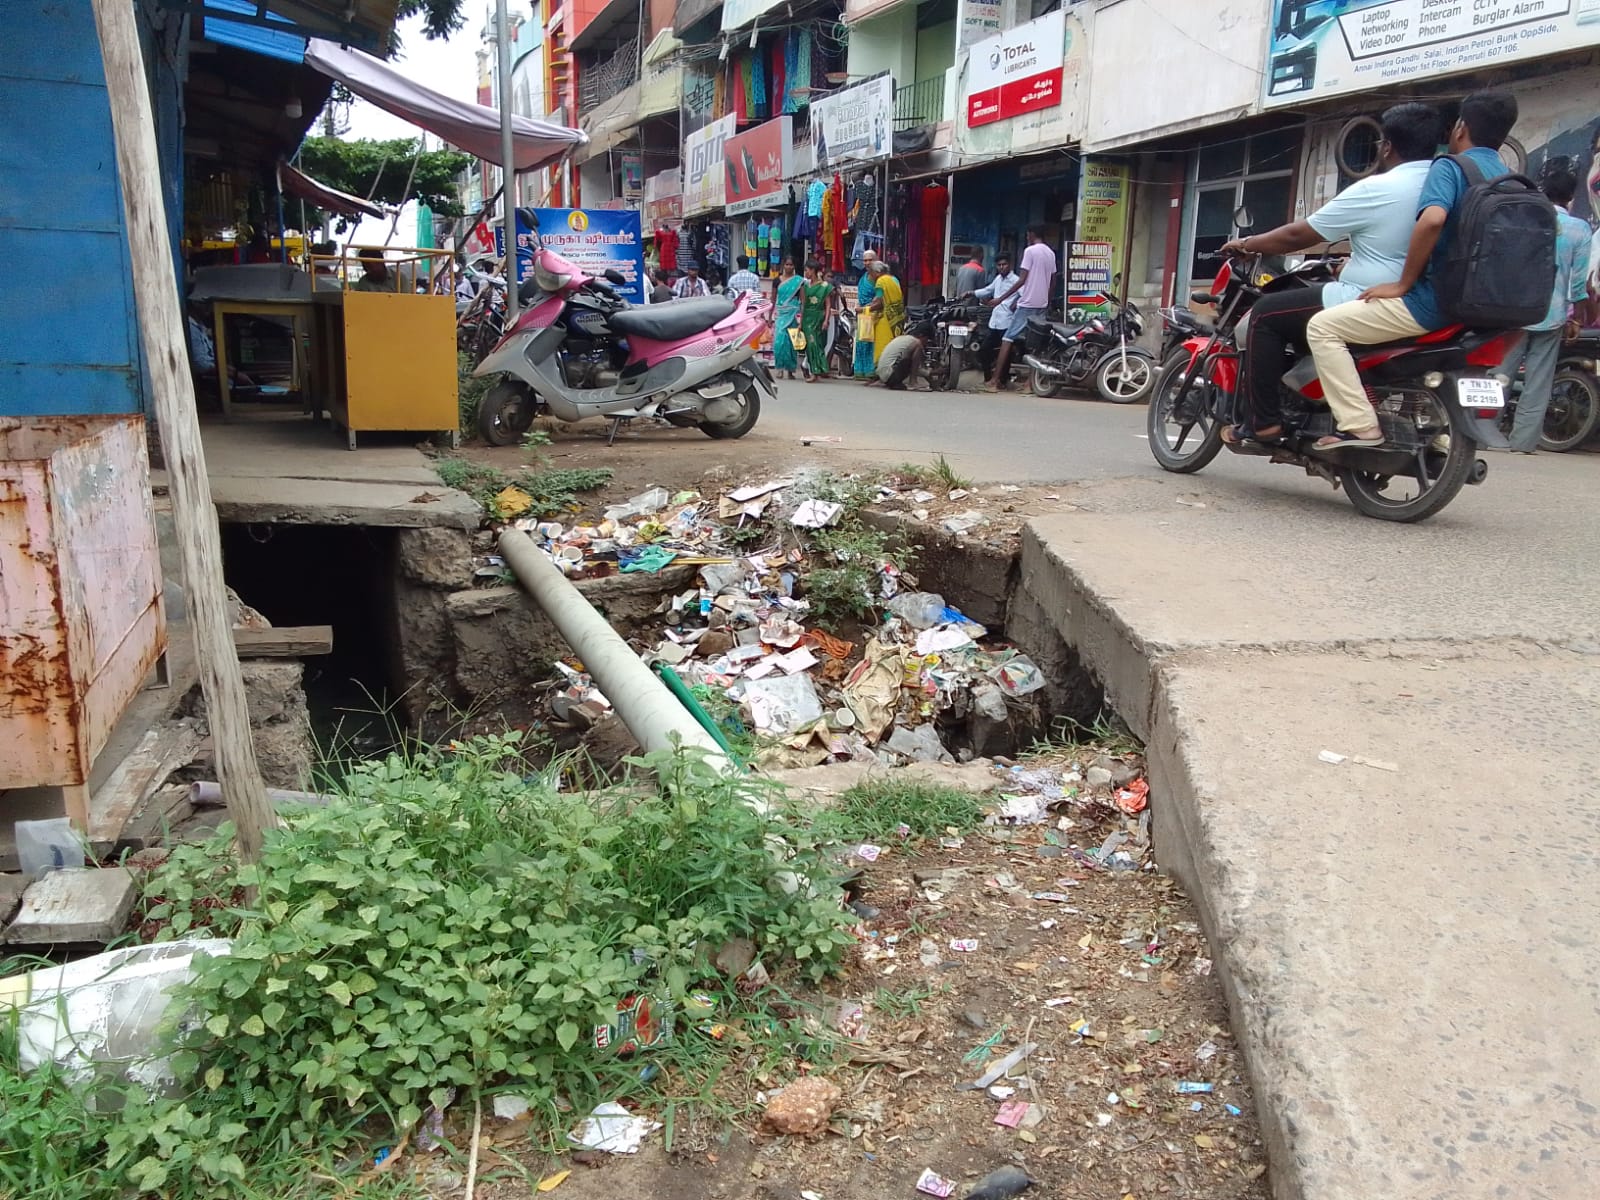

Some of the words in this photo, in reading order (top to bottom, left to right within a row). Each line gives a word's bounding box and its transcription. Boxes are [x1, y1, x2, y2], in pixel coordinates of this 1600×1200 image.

[1362, 9, 1390, 24] Laptop
[1420, 6, 1461, 24] Intercam
[1473, 8, 1510, 25] Burglar
[1513, 1, 1544, 16] Alarm
[1361, 18, 1409, 37] Networking
[1418, 24, 1447, 38] Phone
[1360, 38, 1383, 51] Video
[1385, 33, 1406, 46] Door
[1395, 54, 1420, 65] Gandhi
[1446, 44, 1469, 55] Indian
[1471, 38, 1494, 50] Petrol
[1496, 31, 1518, 44] Bunk
[1004, 57, 1037, 75] LUBRICANTS
[1381, 67, 1400, 77] Hotel
[1401, 65, 1418, 75] Noor
[1420, 61, 1430, 71] 1st
[1431, 58, 1451, 69] Floor
[1487, 46, 1502, 57] 607
[1072, 243, 1084, 256] SRI
[1084, 243, 1108, 256] ANAND
[1069, 257, 1110, 270] COMPUTERS
[1071, 272, 1086, 281] CCTV
[1086, 272, 1107, 281] CAMERA
[1470, 380, 1482, 388] TN
[1482, 381, 1492, 389] 31
[1466, 394, 1478, 403] BC
